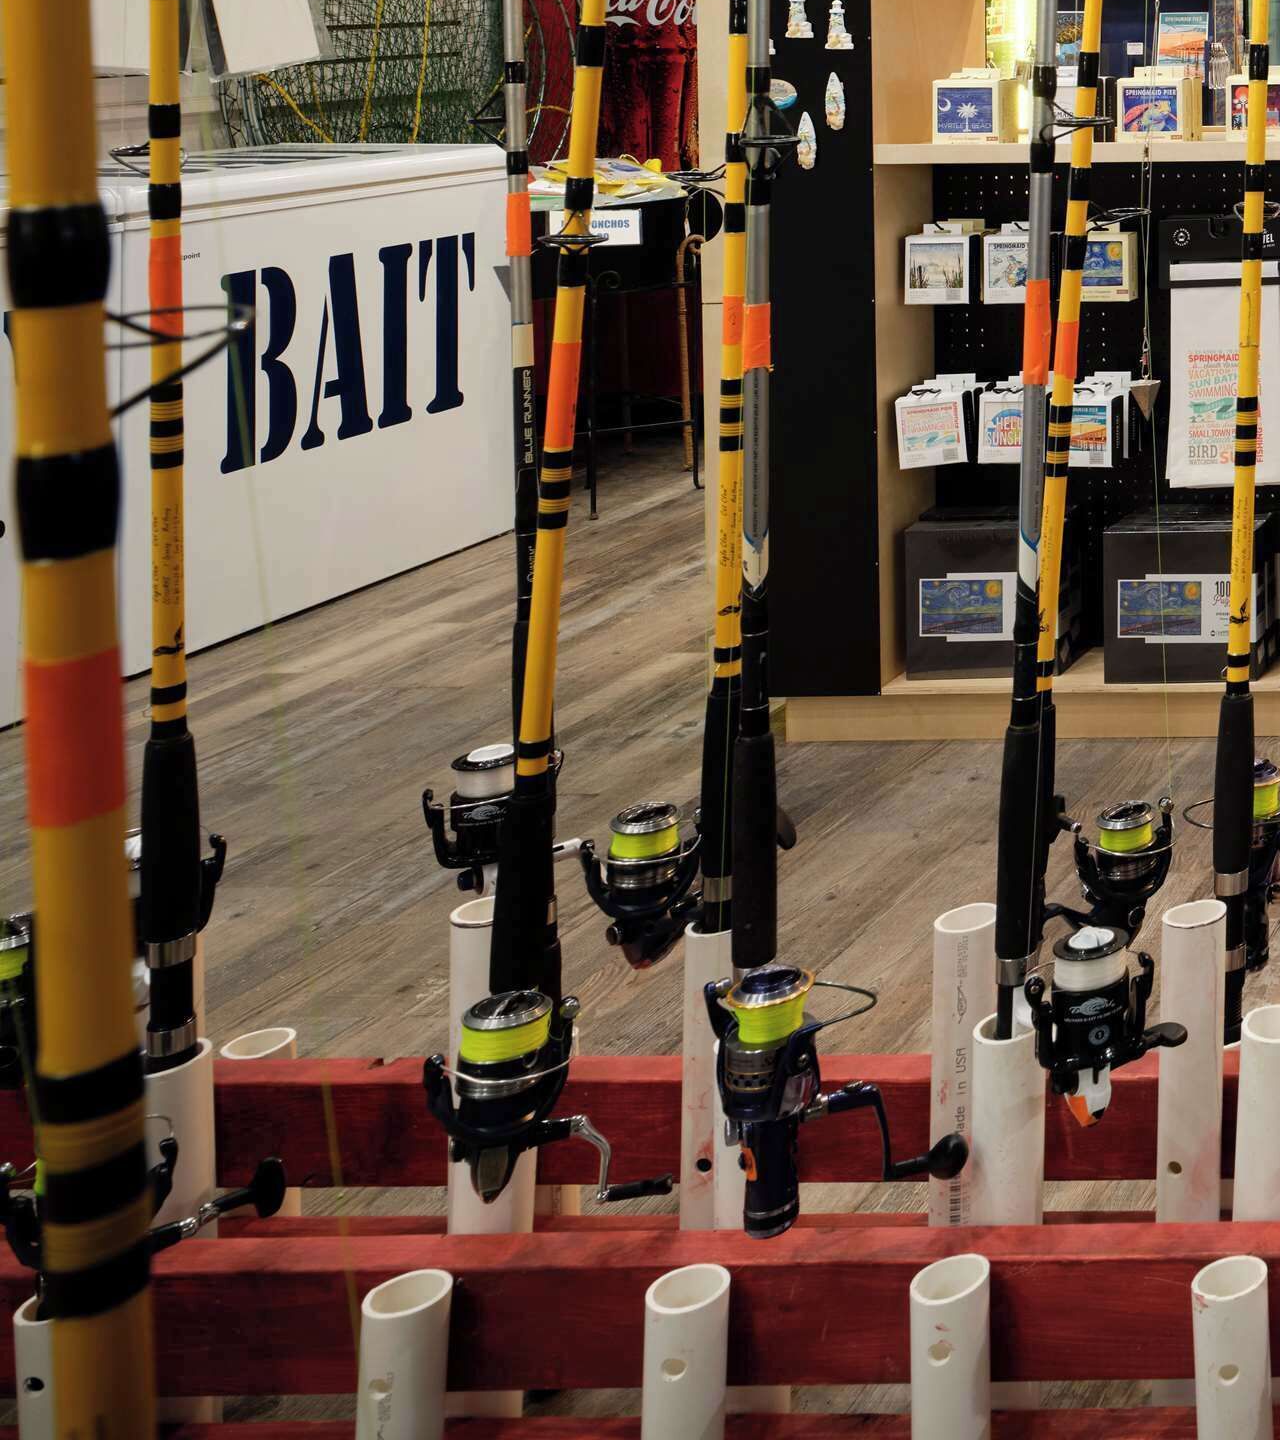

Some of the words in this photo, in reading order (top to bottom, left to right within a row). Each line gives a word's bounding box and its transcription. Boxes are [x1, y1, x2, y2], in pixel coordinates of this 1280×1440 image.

[1125, 88, 1161, 96] SPRINGMAID
[1163, 88, 1177, 96] PIER
[591, 218, 630, 230] ONCHOS
[993, 242, 1026, 250] SPRINGMAID
[220, 232, 475, 474] BAIT
[1188, 353, 1240, 363] SPRINGMAID
[1188, 377, 1211, 389] SUN
[522, 369, 535, 423] RUNNER
[1188, 382, 1238, 399] SWIMMING
[524, 428, 534, 463] BLUE
[1188, 444, 1218, 459] BIRD
[956, 1047, 967, 1076] USA
[956, 1082, 967, 1096] in
